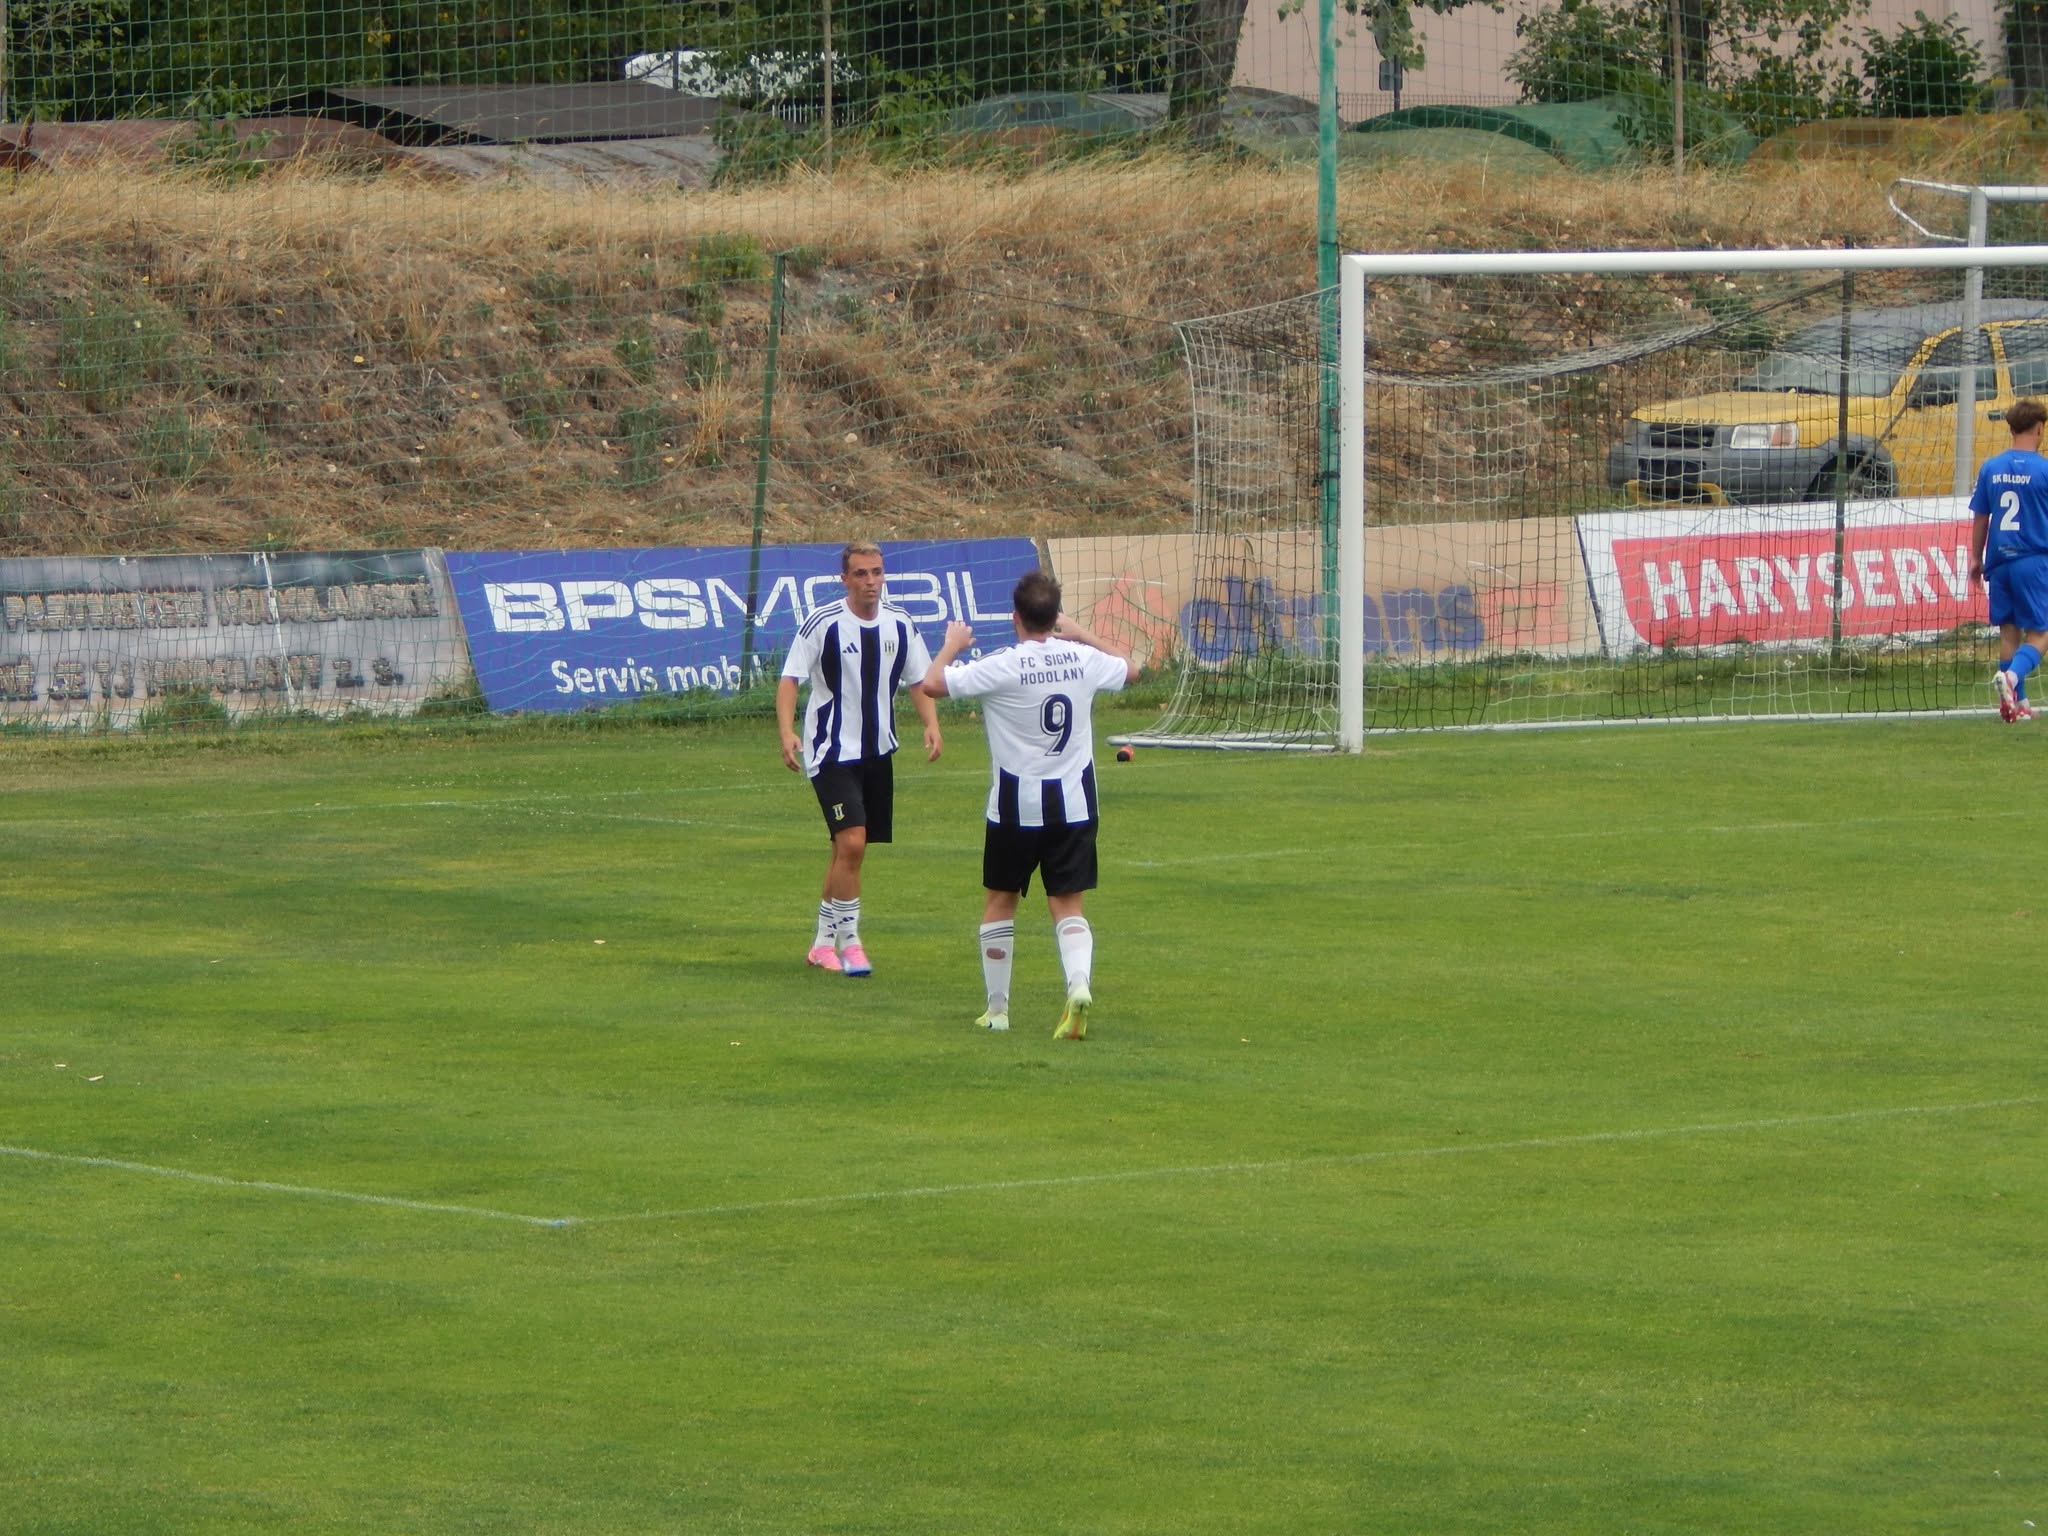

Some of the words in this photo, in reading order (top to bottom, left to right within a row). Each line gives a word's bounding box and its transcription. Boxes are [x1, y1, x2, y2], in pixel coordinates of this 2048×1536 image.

[2000, 490, 2020, 531] 2
[1643, 545, 1989, 621] HARYSERV
[551, 657, 658, 692] Servis
[1020, 656, 1036, 669] FC
[1045, 652, 1081, 667] SIGMA
[1020, 666, 1086, 685] HODOLANY
[1040, 694, 1073, 757] 9
